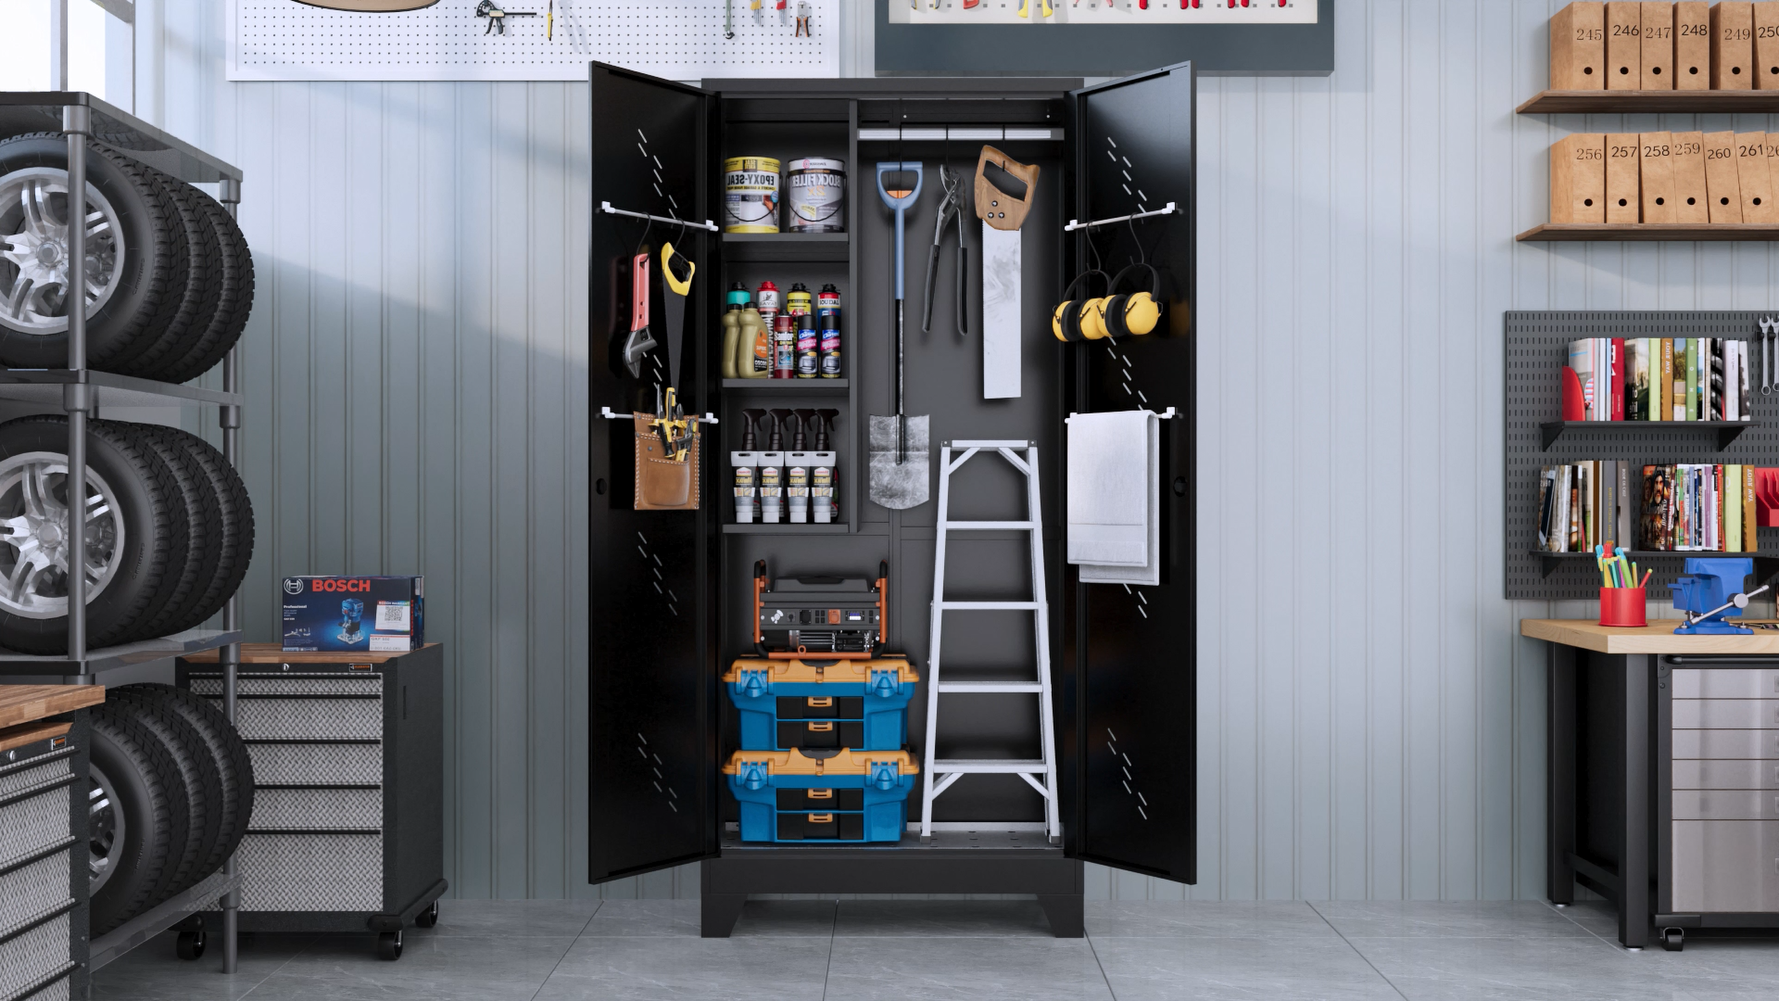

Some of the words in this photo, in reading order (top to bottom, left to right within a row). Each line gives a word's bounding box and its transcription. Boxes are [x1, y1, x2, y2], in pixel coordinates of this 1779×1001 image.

[1576, 29, 1602, 41] 245
[1613, 24, 1640, 36] 246
[1645, 27, 1671, 39] 247
[1681, 24, 1708, 36] 248
[1724, 28, 1750, 40] 249
[1576, 148, 1602, 161] 256
[1611, 146, 1637, 158] 257
[1644, 145, 1670, 157] 258
[1674, 142, 1701, 156] 259
[1707, 148, 1731, 160] 260
[1740, 144, 1764, 157] 261
[312, 579, 371, 592] BOSCH
